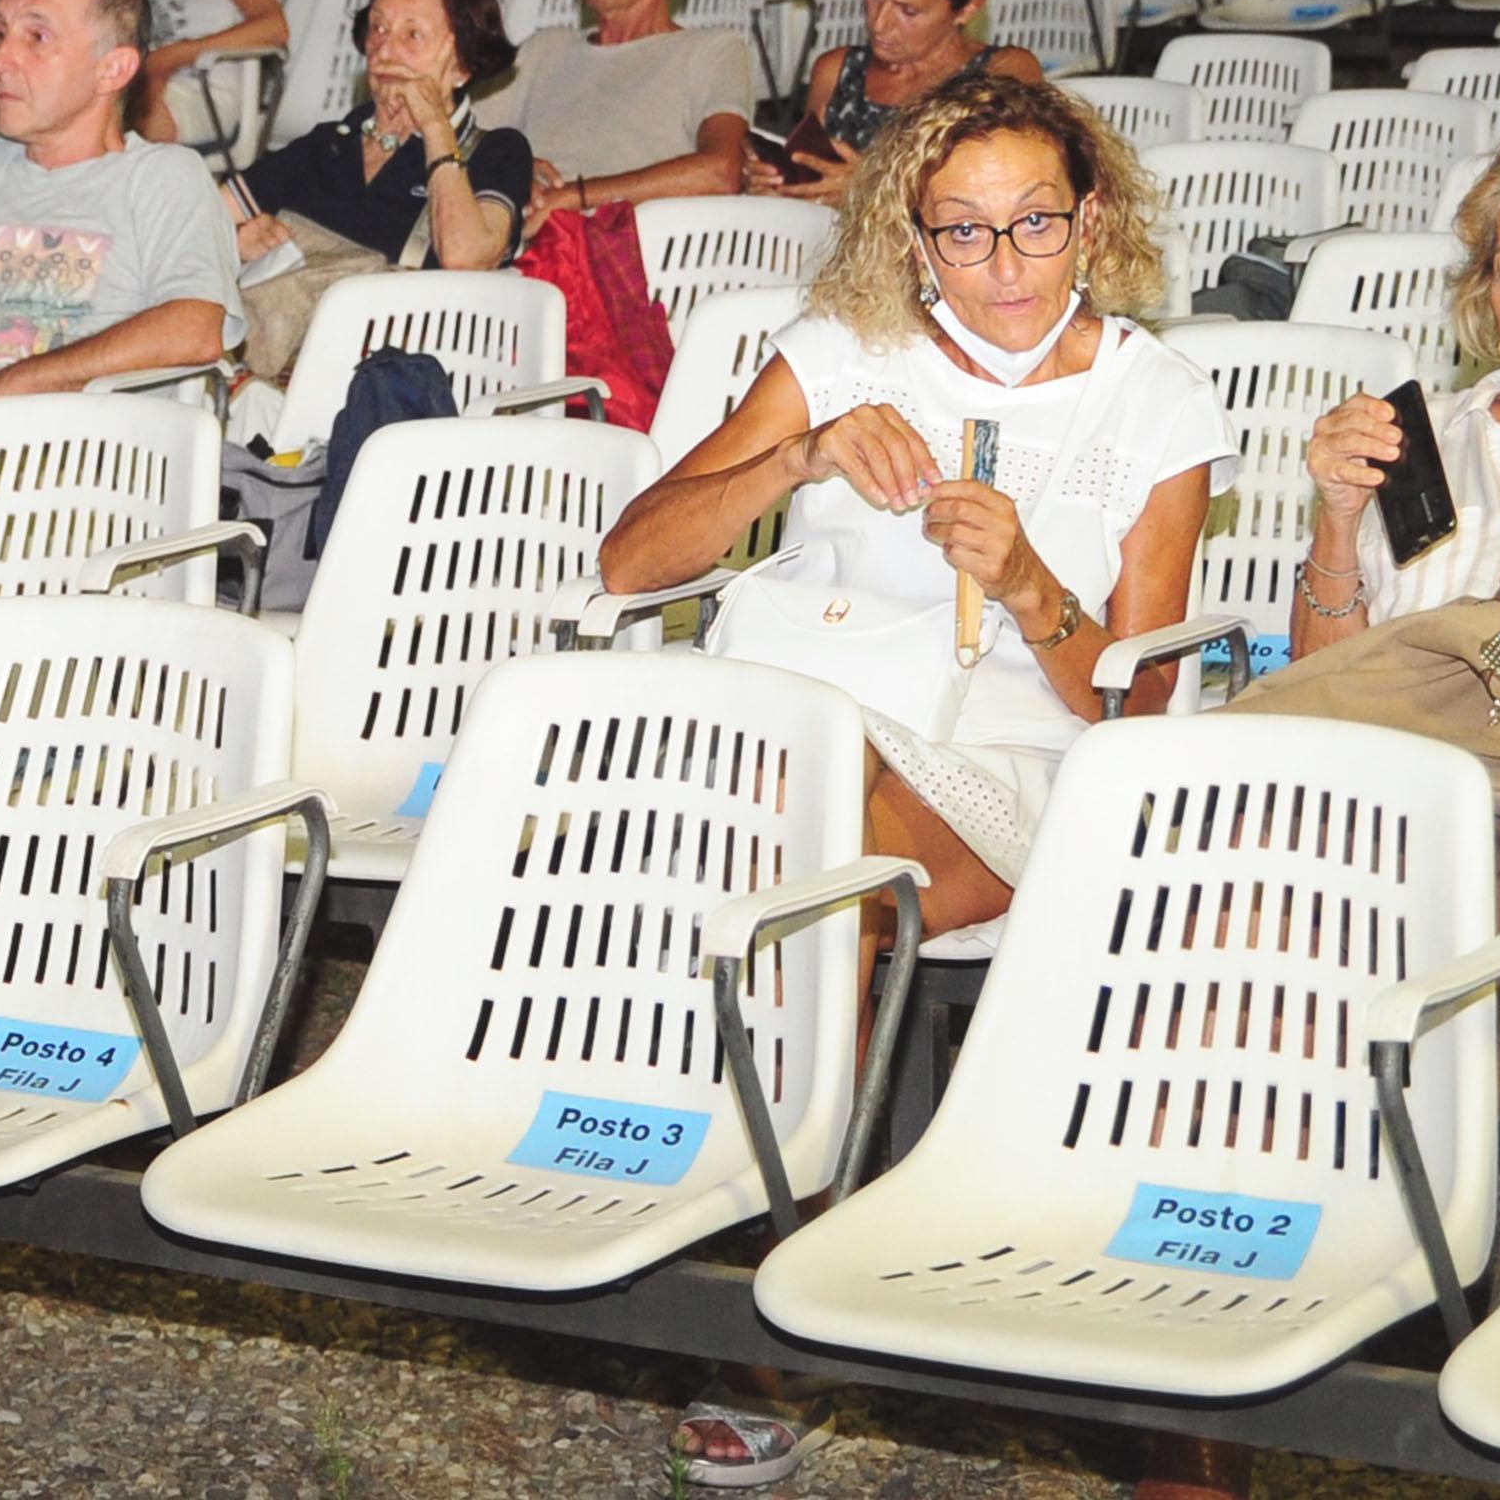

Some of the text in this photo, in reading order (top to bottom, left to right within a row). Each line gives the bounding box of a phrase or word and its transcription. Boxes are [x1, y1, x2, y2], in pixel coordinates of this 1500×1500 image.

[1204, 640, 1273, 657] Poto
[0, 1032, 115, 1067] Posto 4
[57, 1078, 81, 1092] J
[556, 1108, 683, 1146] Posto 3
[554, 1147, 648, 1174] Fila J
[1152, 1199, 1291, 1236] Posto 2
[1155, 1240, 1257, 1269] Fila J
